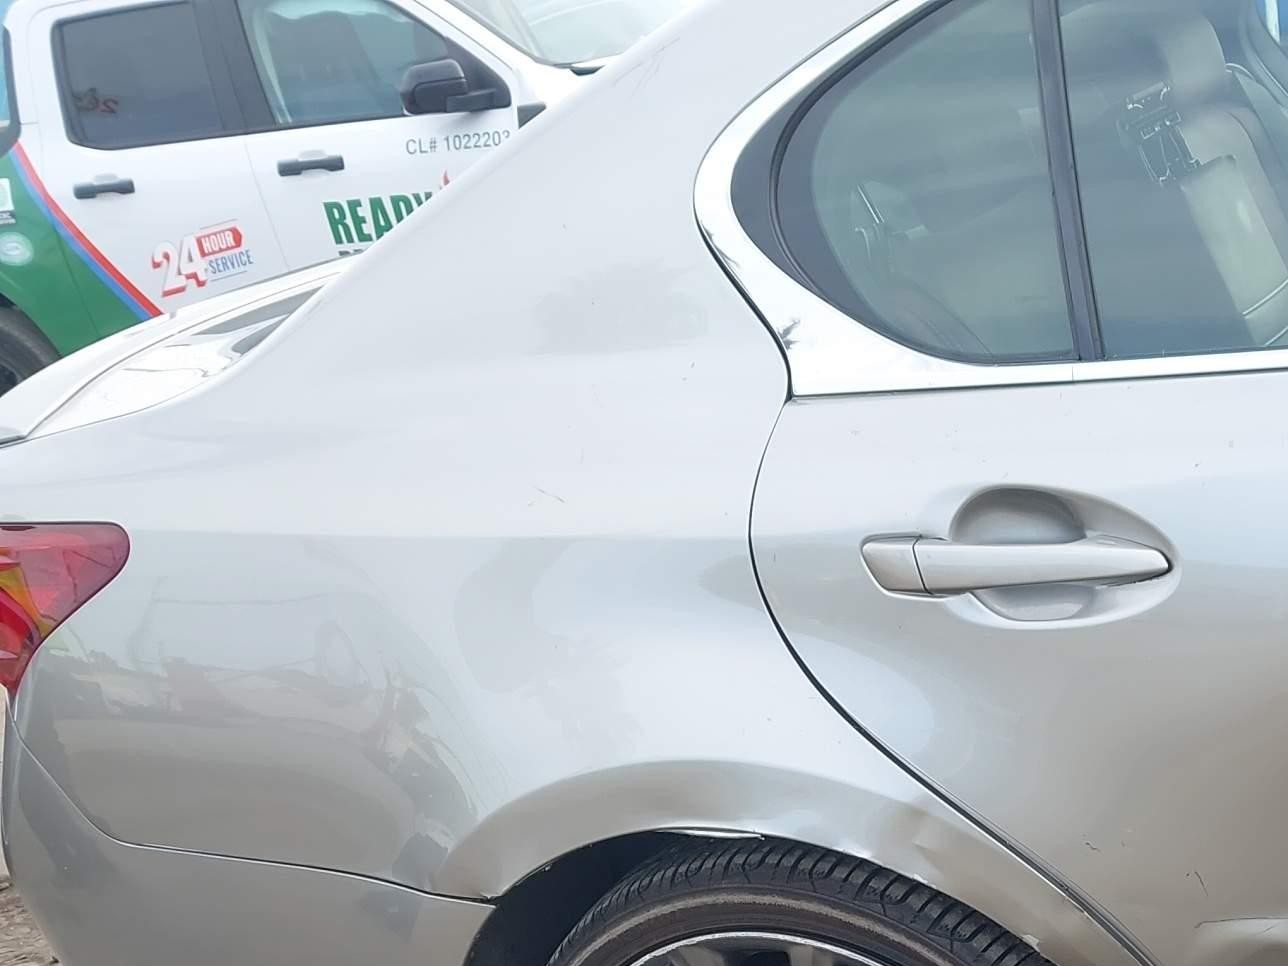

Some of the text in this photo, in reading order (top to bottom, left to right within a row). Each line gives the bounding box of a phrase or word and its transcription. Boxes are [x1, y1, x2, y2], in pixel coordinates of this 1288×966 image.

[406, 137, 437, 155] CL#
[152, 229, 236, 297] 24 HOUR
[208, 249, 255, 274] SERVICE
